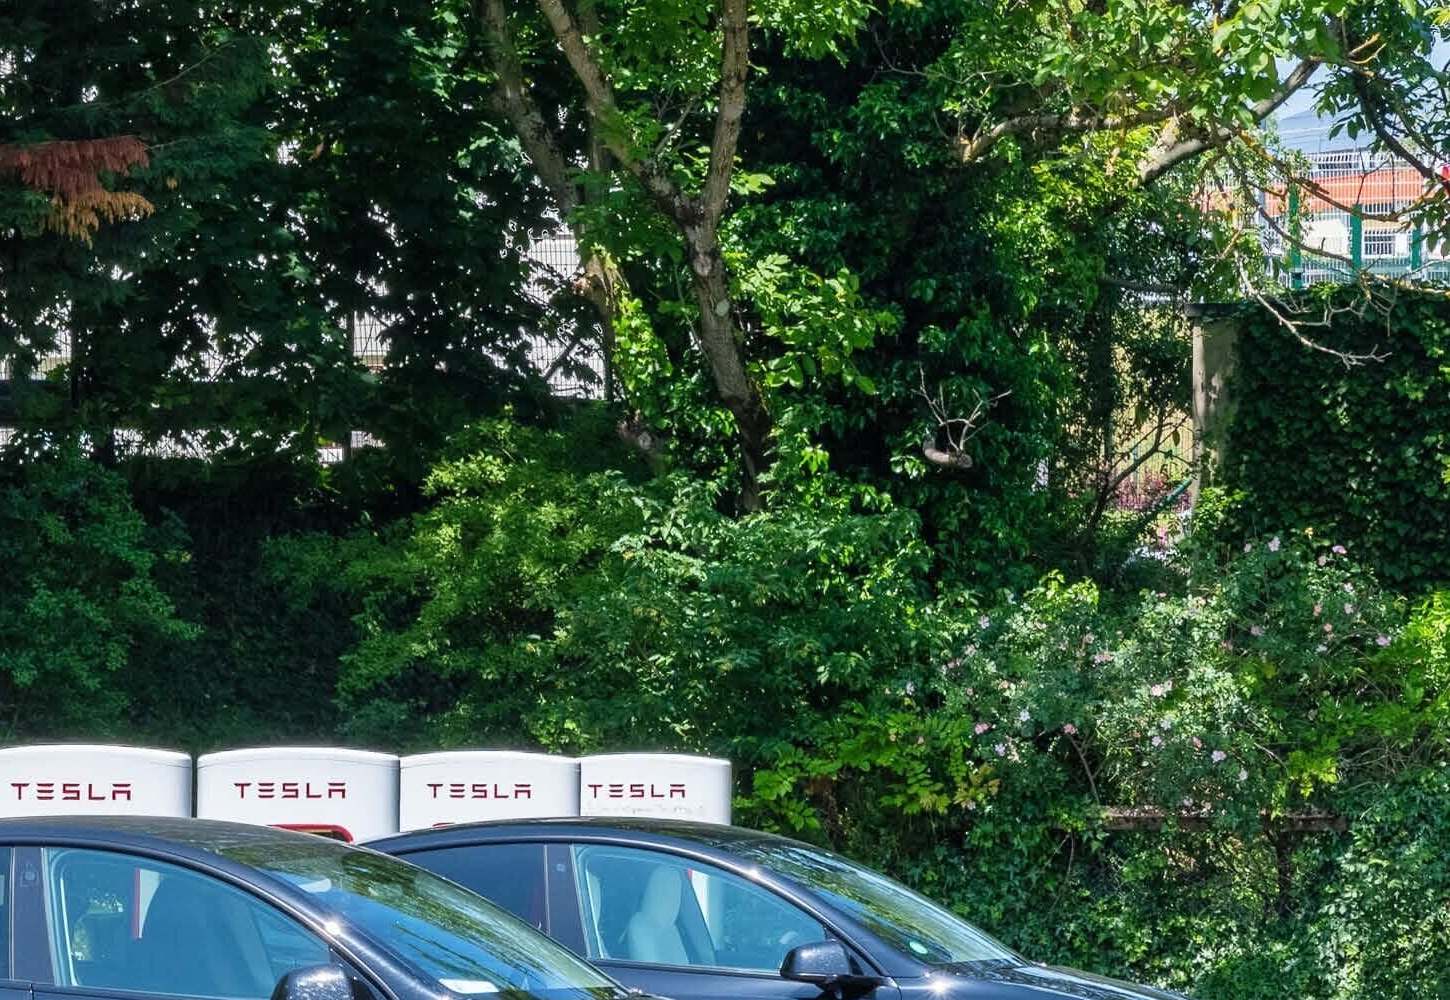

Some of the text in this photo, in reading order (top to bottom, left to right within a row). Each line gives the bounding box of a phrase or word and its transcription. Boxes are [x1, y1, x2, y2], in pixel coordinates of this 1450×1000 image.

[12, 783, 131, 800] TESLA
[234, 783, 345, 798] TESLA
[428, 784, 531, 798] TESLA
[588, 784, 685, 798] TESLA
